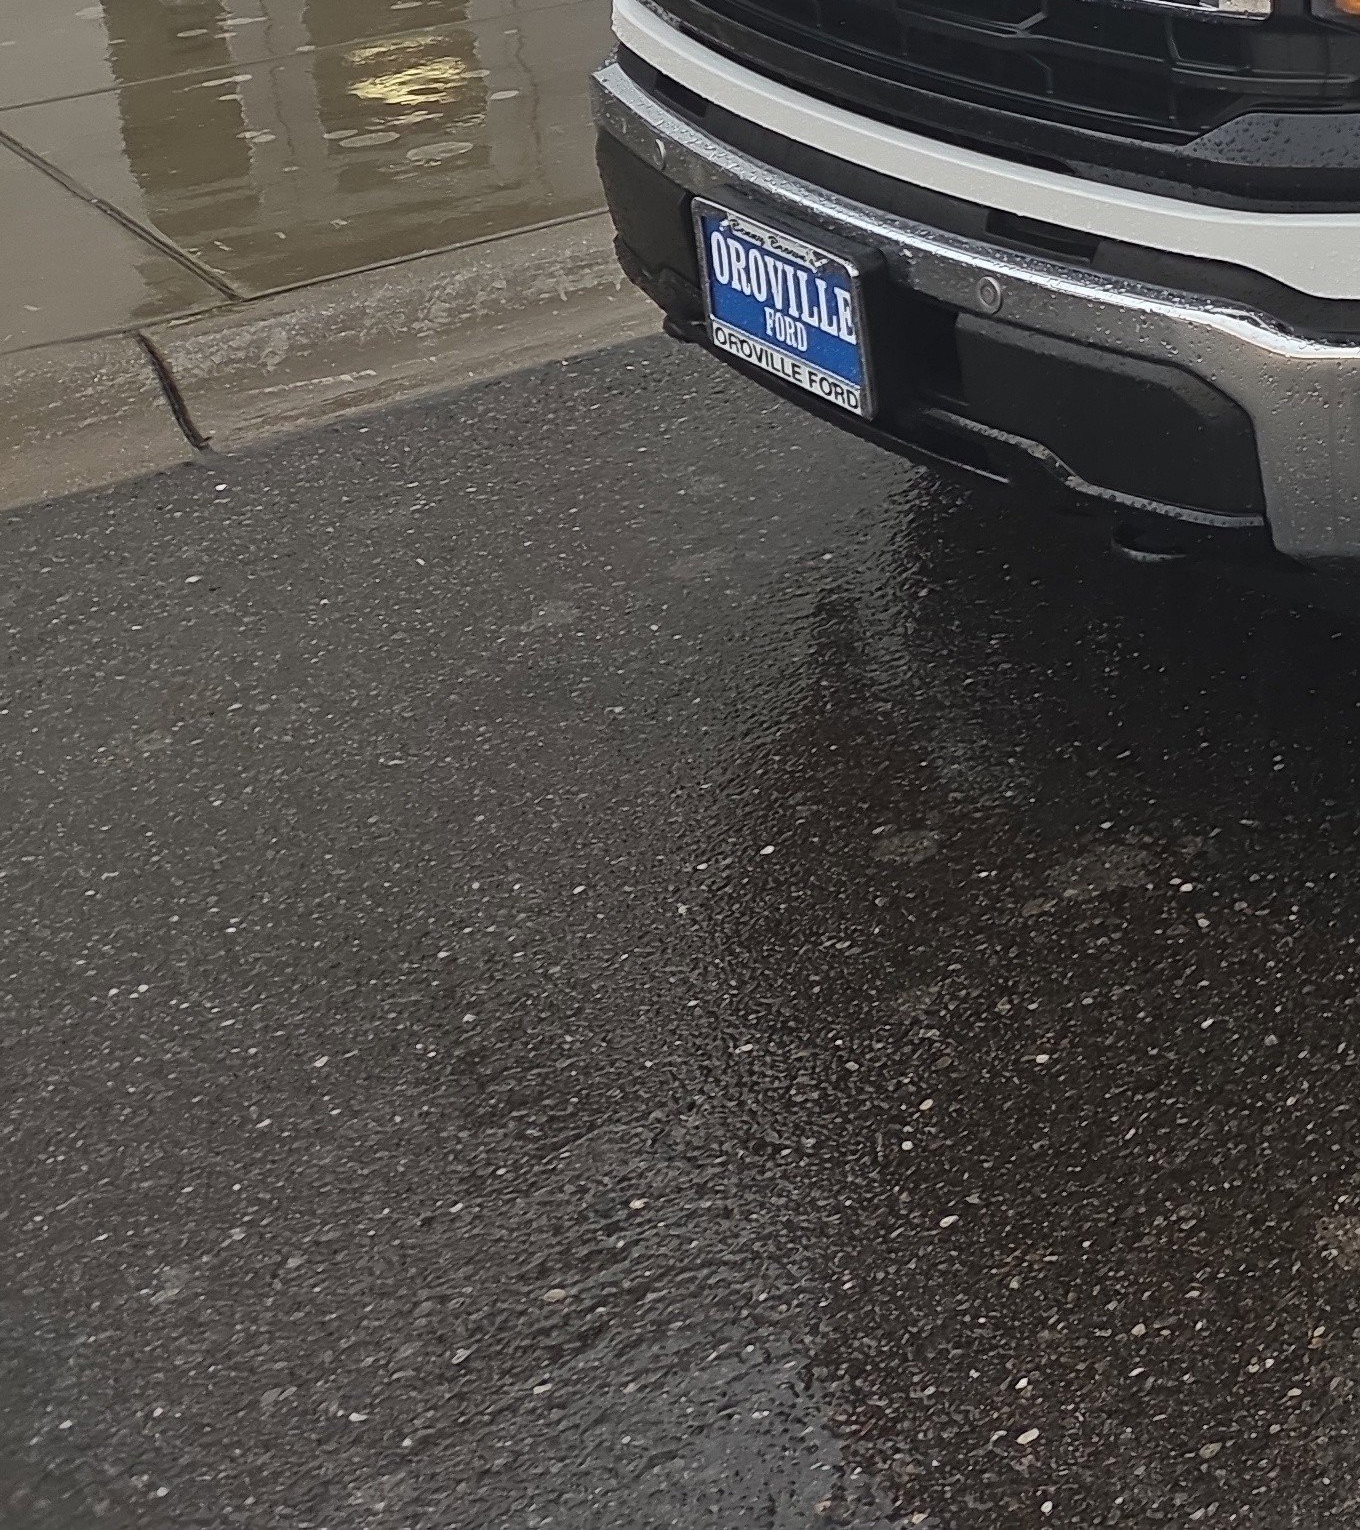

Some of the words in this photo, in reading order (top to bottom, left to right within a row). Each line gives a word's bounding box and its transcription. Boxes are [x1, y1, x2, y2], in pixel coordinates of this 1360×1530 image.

[710, 230, 857, 346] OROVILLE
[763, 306, 808, 352] FORD
[714, 326, 803, 380] OROVILLE
[808, 371, 859, 411] FORD
